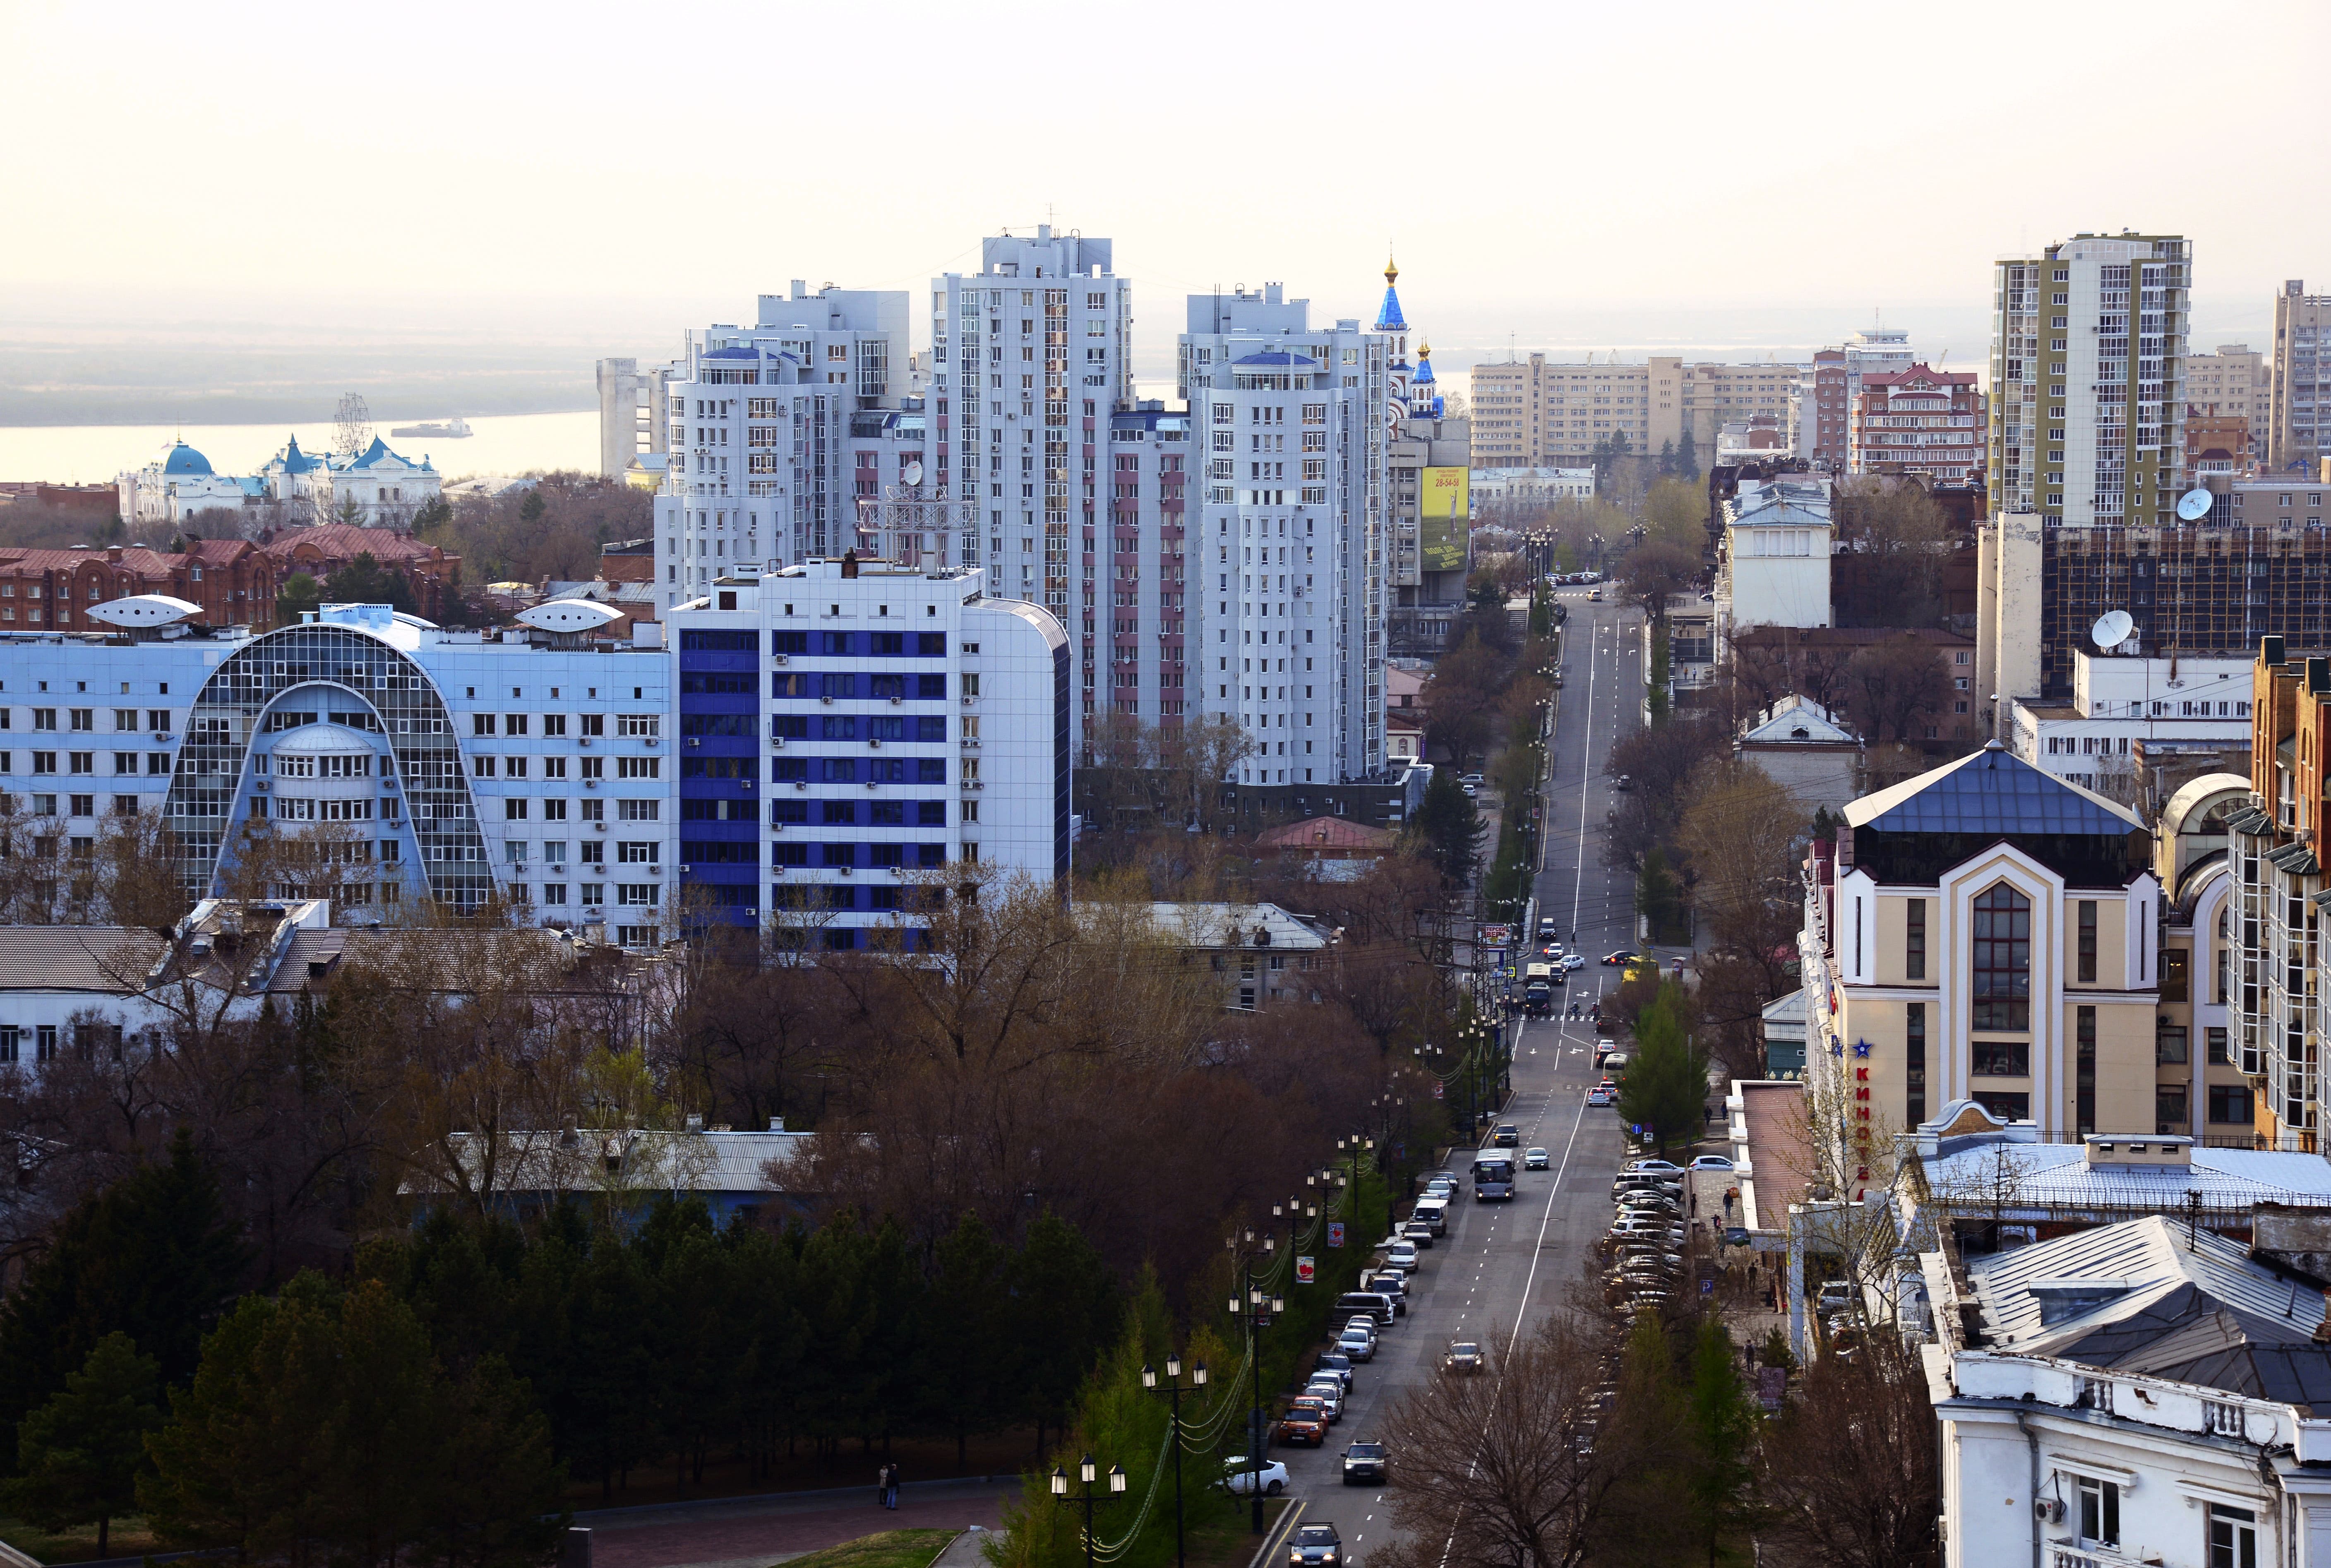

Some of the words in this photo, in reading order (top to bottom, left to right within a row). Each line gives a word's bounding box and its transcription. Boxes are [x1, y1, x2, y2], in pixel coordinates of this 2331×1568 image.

[1436, 478, 1460, 487] 28-54-58
[1424, 547, 1445, 555] ПОЛЕ
[1703, 1282, 1710, 1292] P
